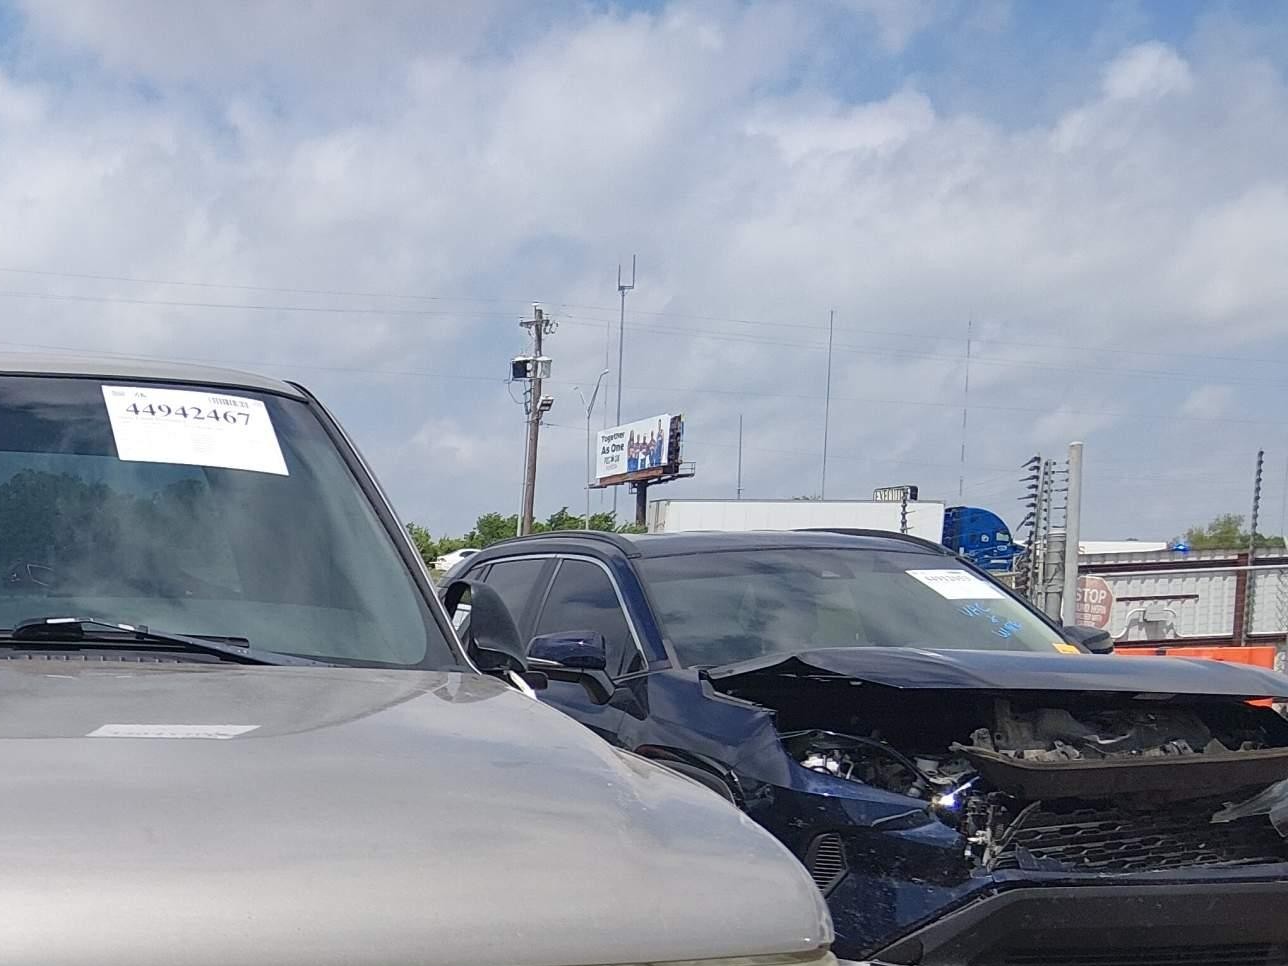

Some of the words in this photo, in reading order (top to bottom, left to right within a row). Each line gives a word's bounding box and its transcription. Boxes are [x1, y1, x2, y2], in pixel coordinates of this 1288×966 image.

[126, 402, 250, 426] 44942467
[601, 446, 610, 455] As
[611, 443, 624, 453] One
[1076, 588, 1107, 604] STOP
